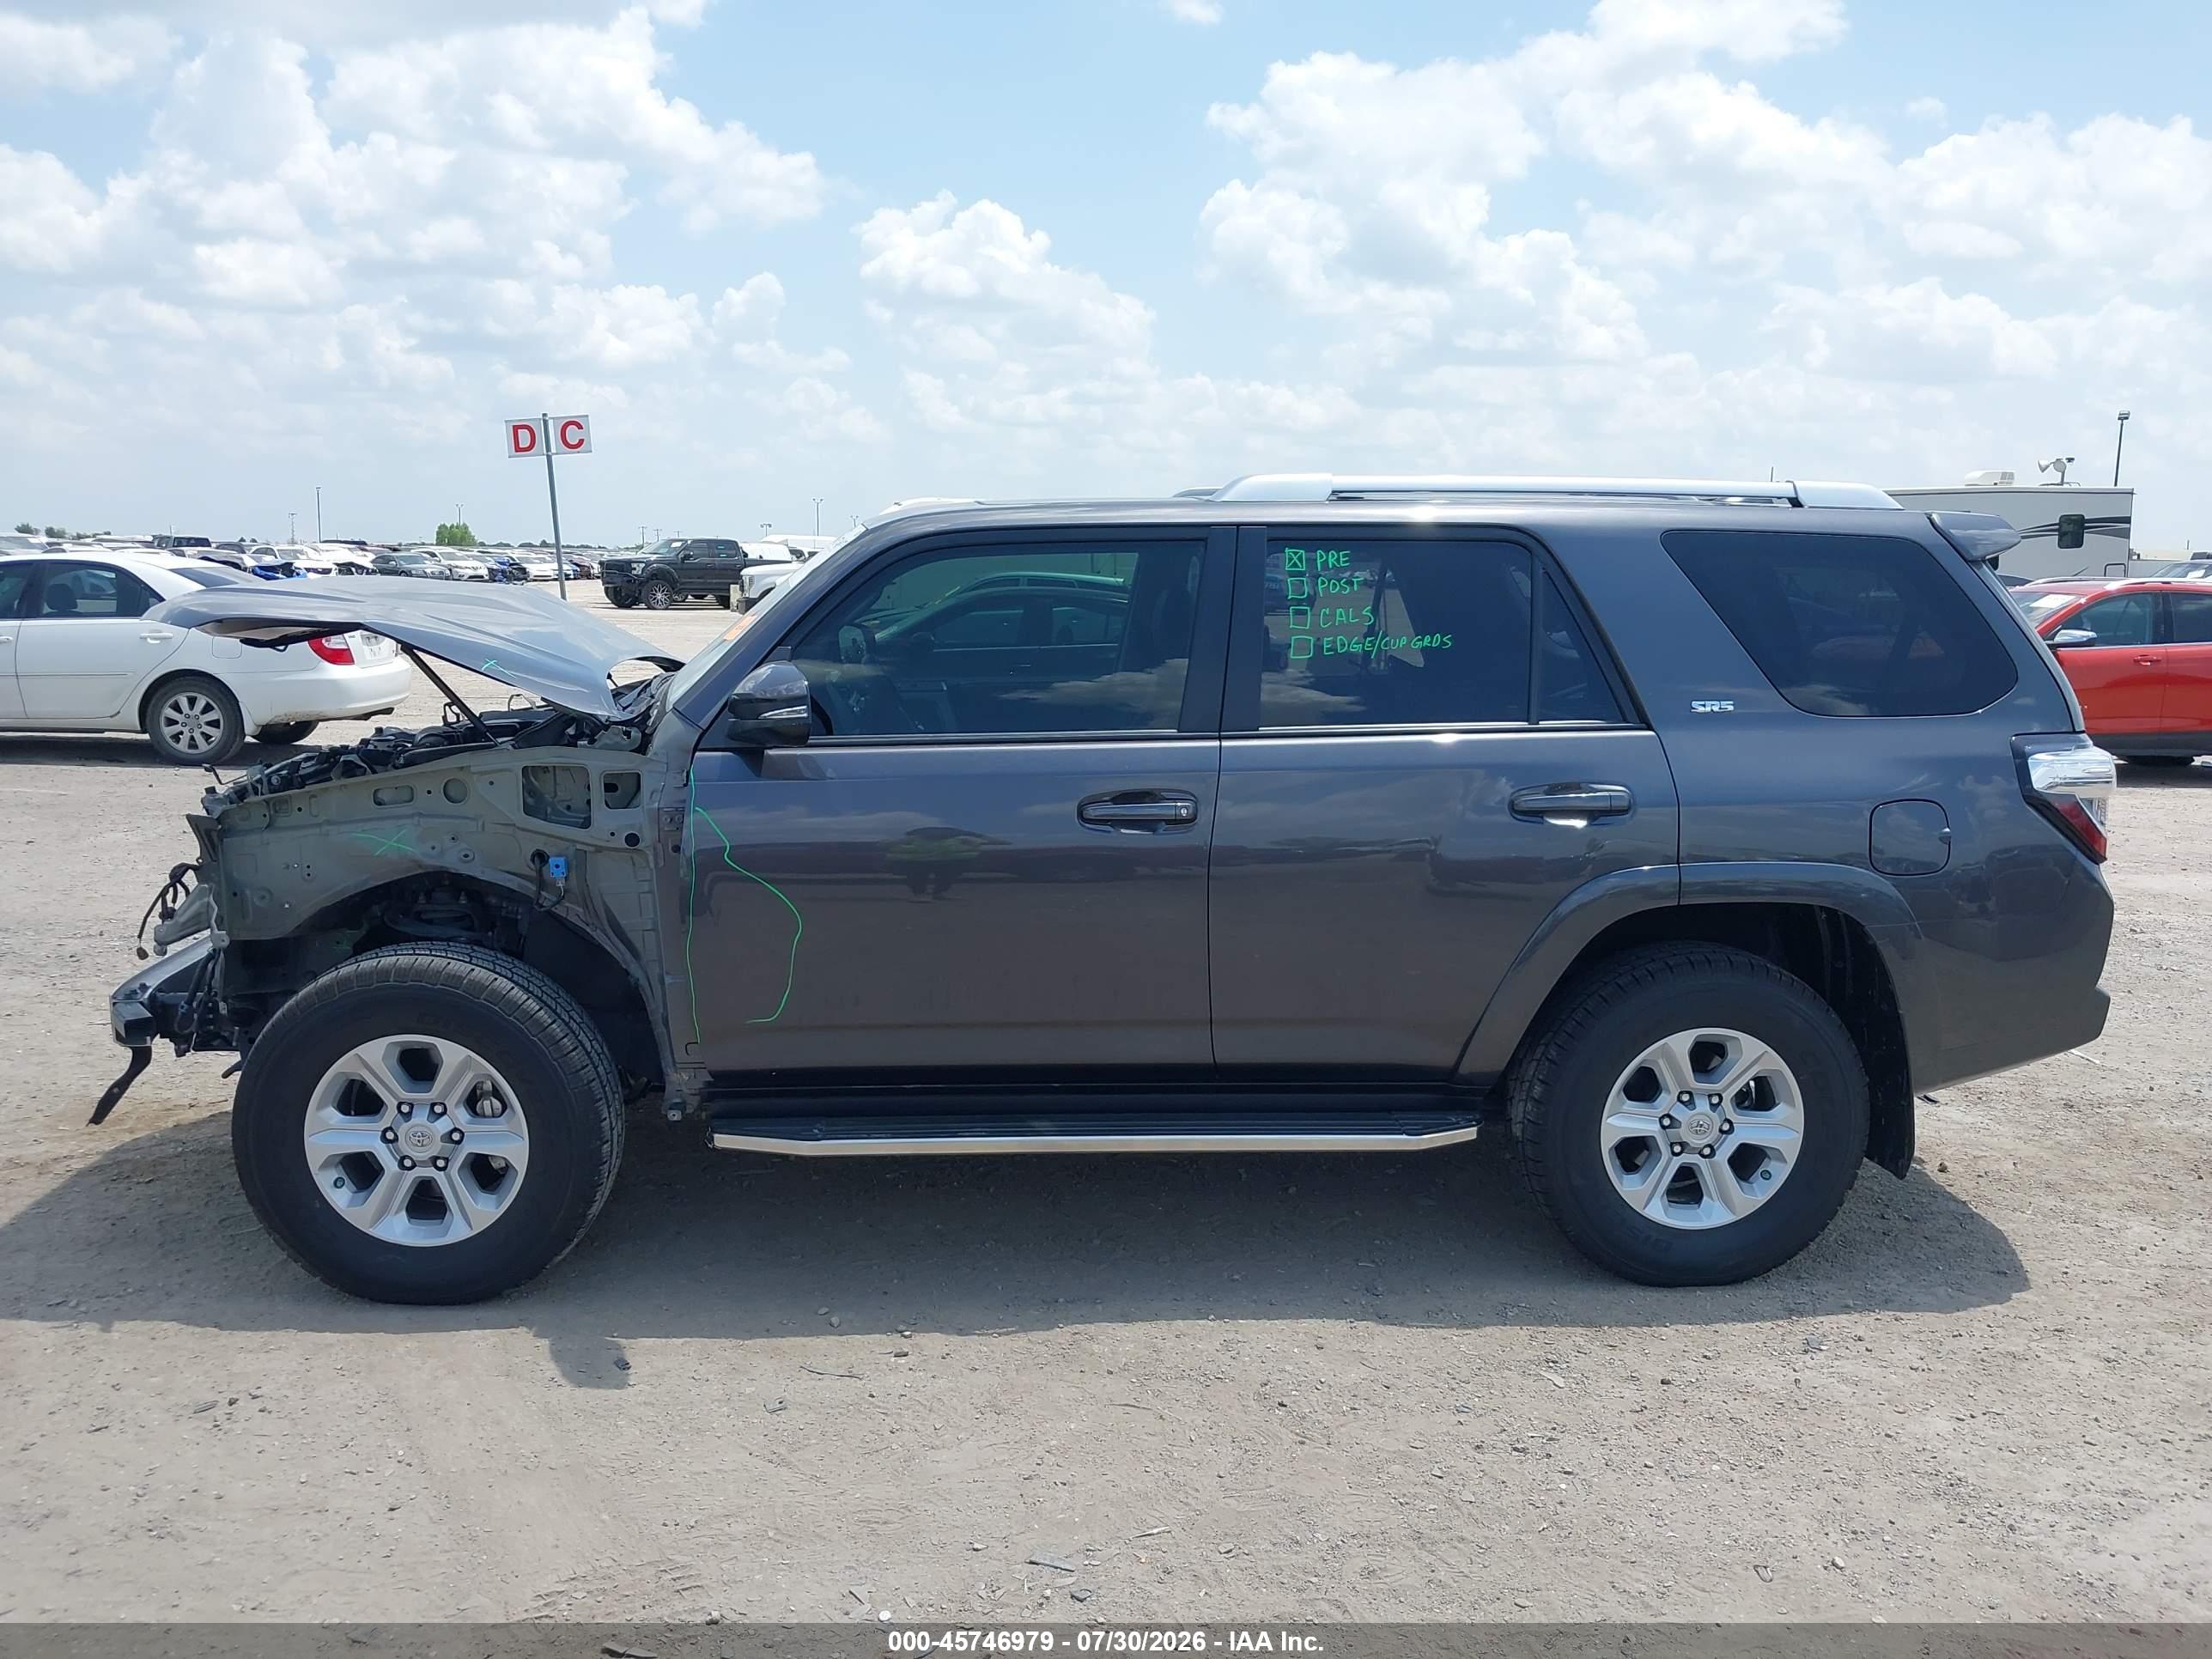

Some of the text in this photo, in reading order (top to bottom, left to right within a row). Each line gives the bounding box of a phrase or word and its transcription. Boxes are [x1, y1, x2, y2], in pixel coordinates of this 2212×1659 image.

[512, 423, 537, 453] D
[559, 419, 585, 450] C
[1316, 550, 1352, 572] PRE
[1316, 576, 1365, 598] POST
[1319, 605, 1375, 629] CALS
[1322, 629, 1453, 659] EDGE/CUP GRDS
[1689, 700, 1735, 714] SR5
